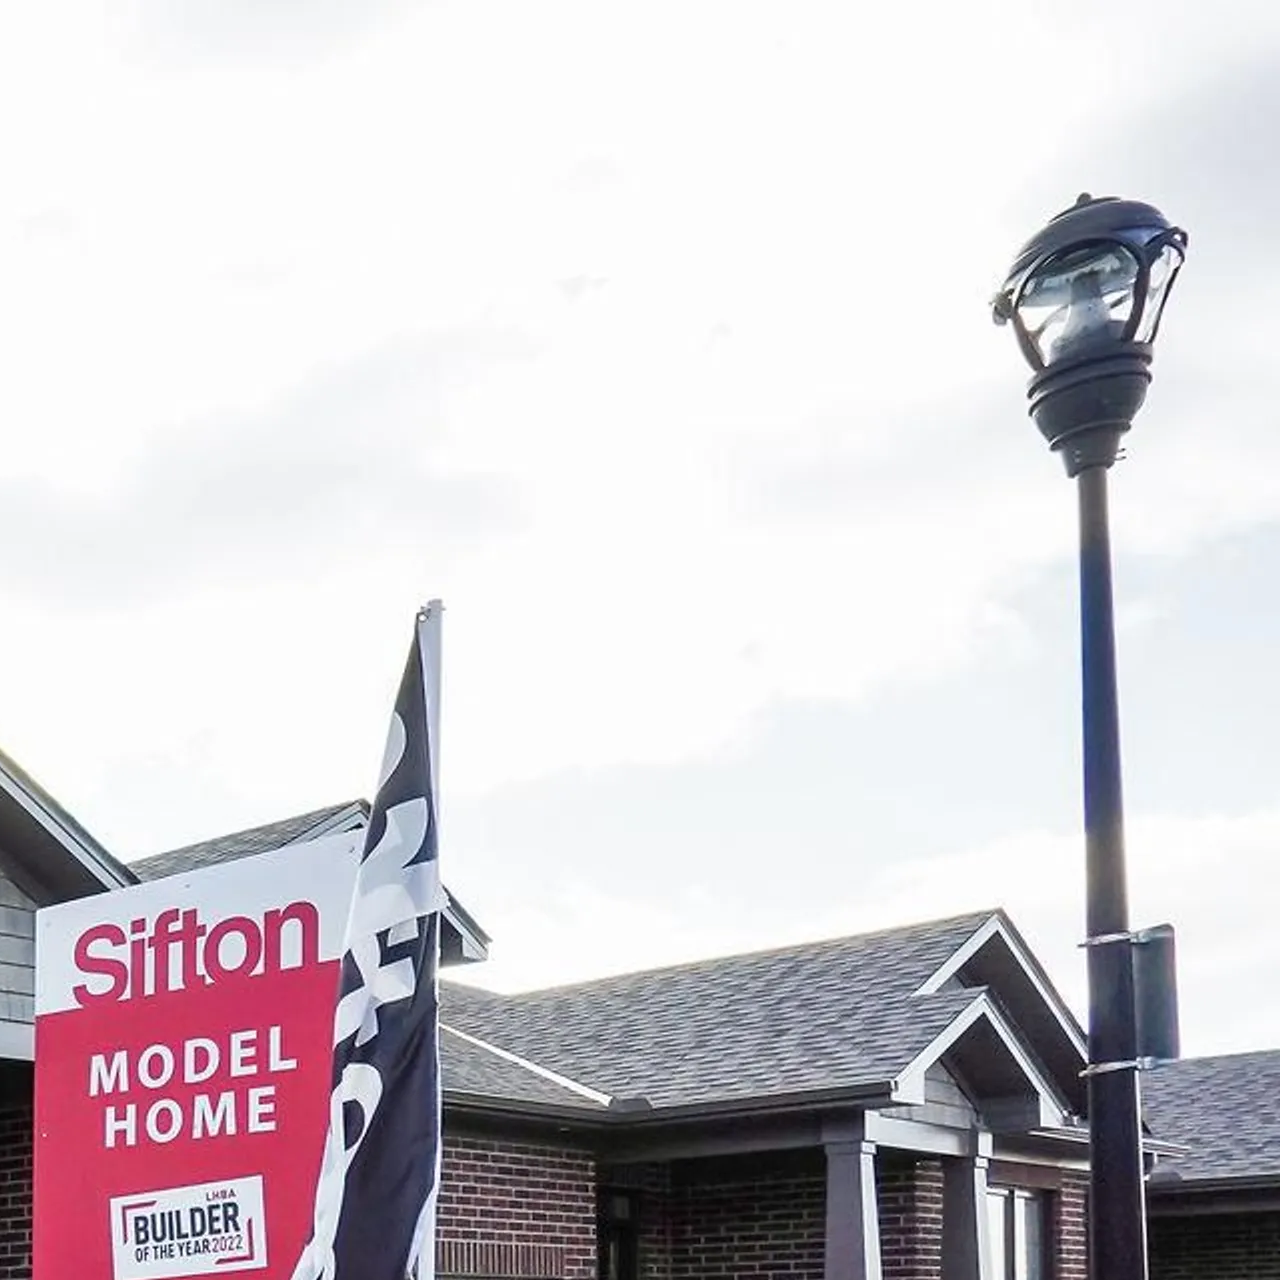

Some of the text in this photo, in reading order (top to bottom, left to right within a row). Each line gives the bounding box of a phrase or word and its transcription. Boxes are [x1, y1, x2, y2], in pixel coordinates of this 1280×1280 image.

[73, 900, 320, 1008] Sifton
[89, 1025, 298, 1097] MODEL
[104, 1086, 277, 1148] HOME
[134, 1201, 241, 1245] BUILDER
[135, 1234, 244, 1263] OF THE YEAR 2022
